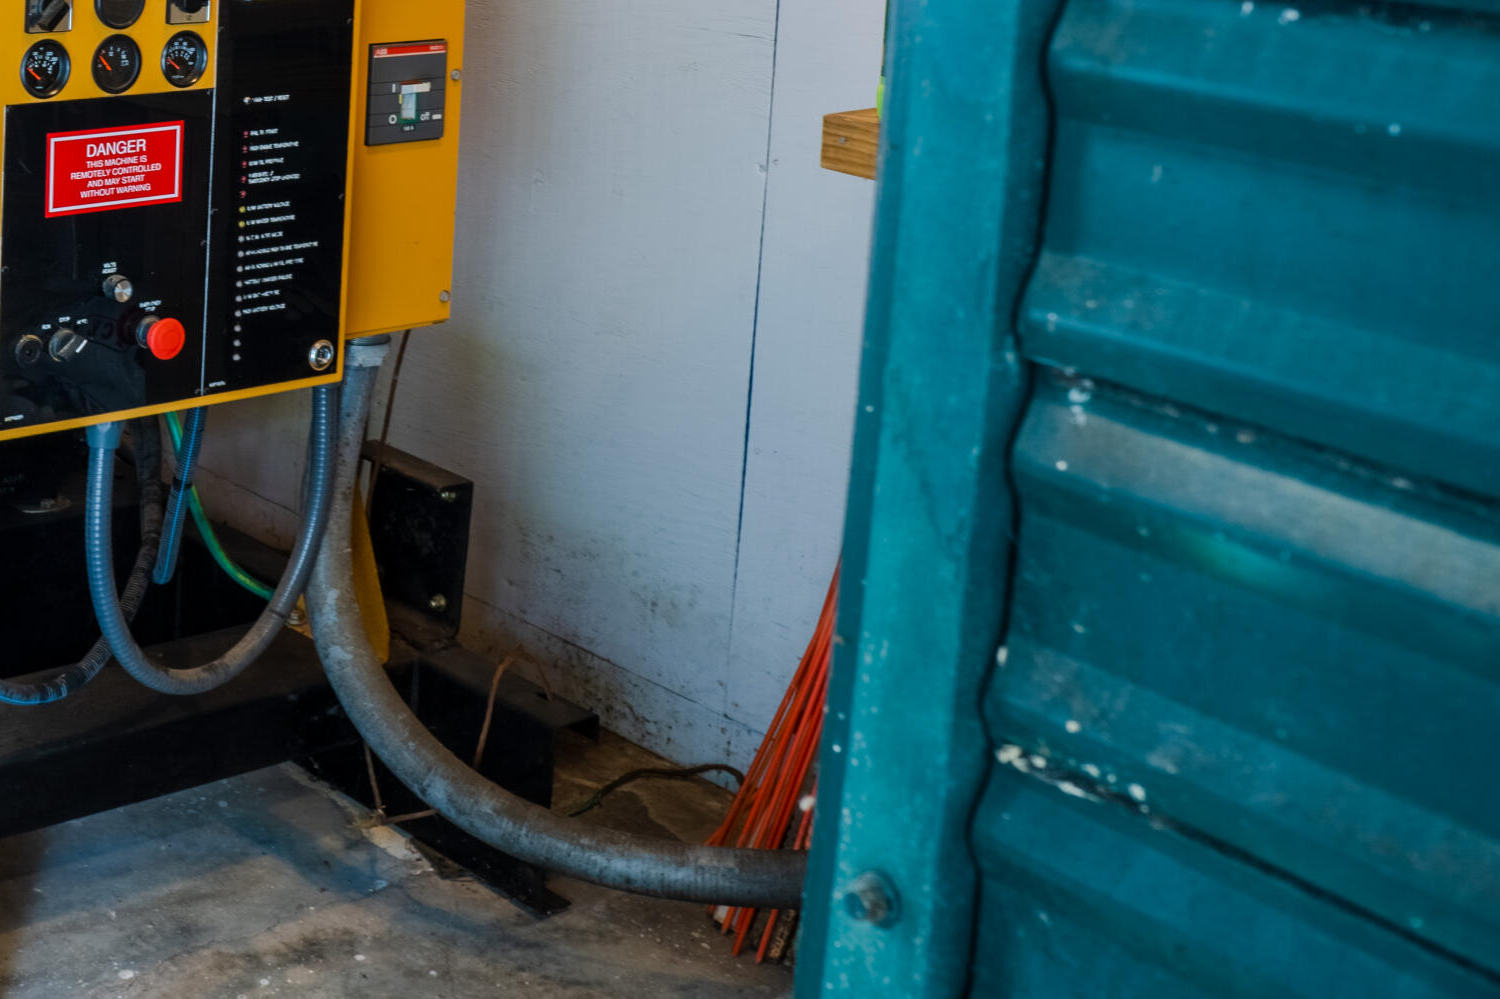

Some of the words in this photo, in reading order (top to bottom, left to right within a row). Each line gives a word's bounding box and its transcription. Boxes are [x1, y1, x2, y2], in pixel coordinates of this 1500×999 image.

[87, 139, 146, 158] DANGER
[86, 160, 103, 169] THIS
[105, 156, 138, 167] MACHINE
[140, 155, 148, 163] IS
[70, 169, 111, 180] REMOTELY
[112, 163, 162, 175] CONTROLLED
[87, 180, 104, 188] AND
[105, 177, 121, 186] MAY
[122, 174, 145, 184] START
[80, 188, 115, 199] WITHOUT
[116, 183, 152, 194] WARNING
